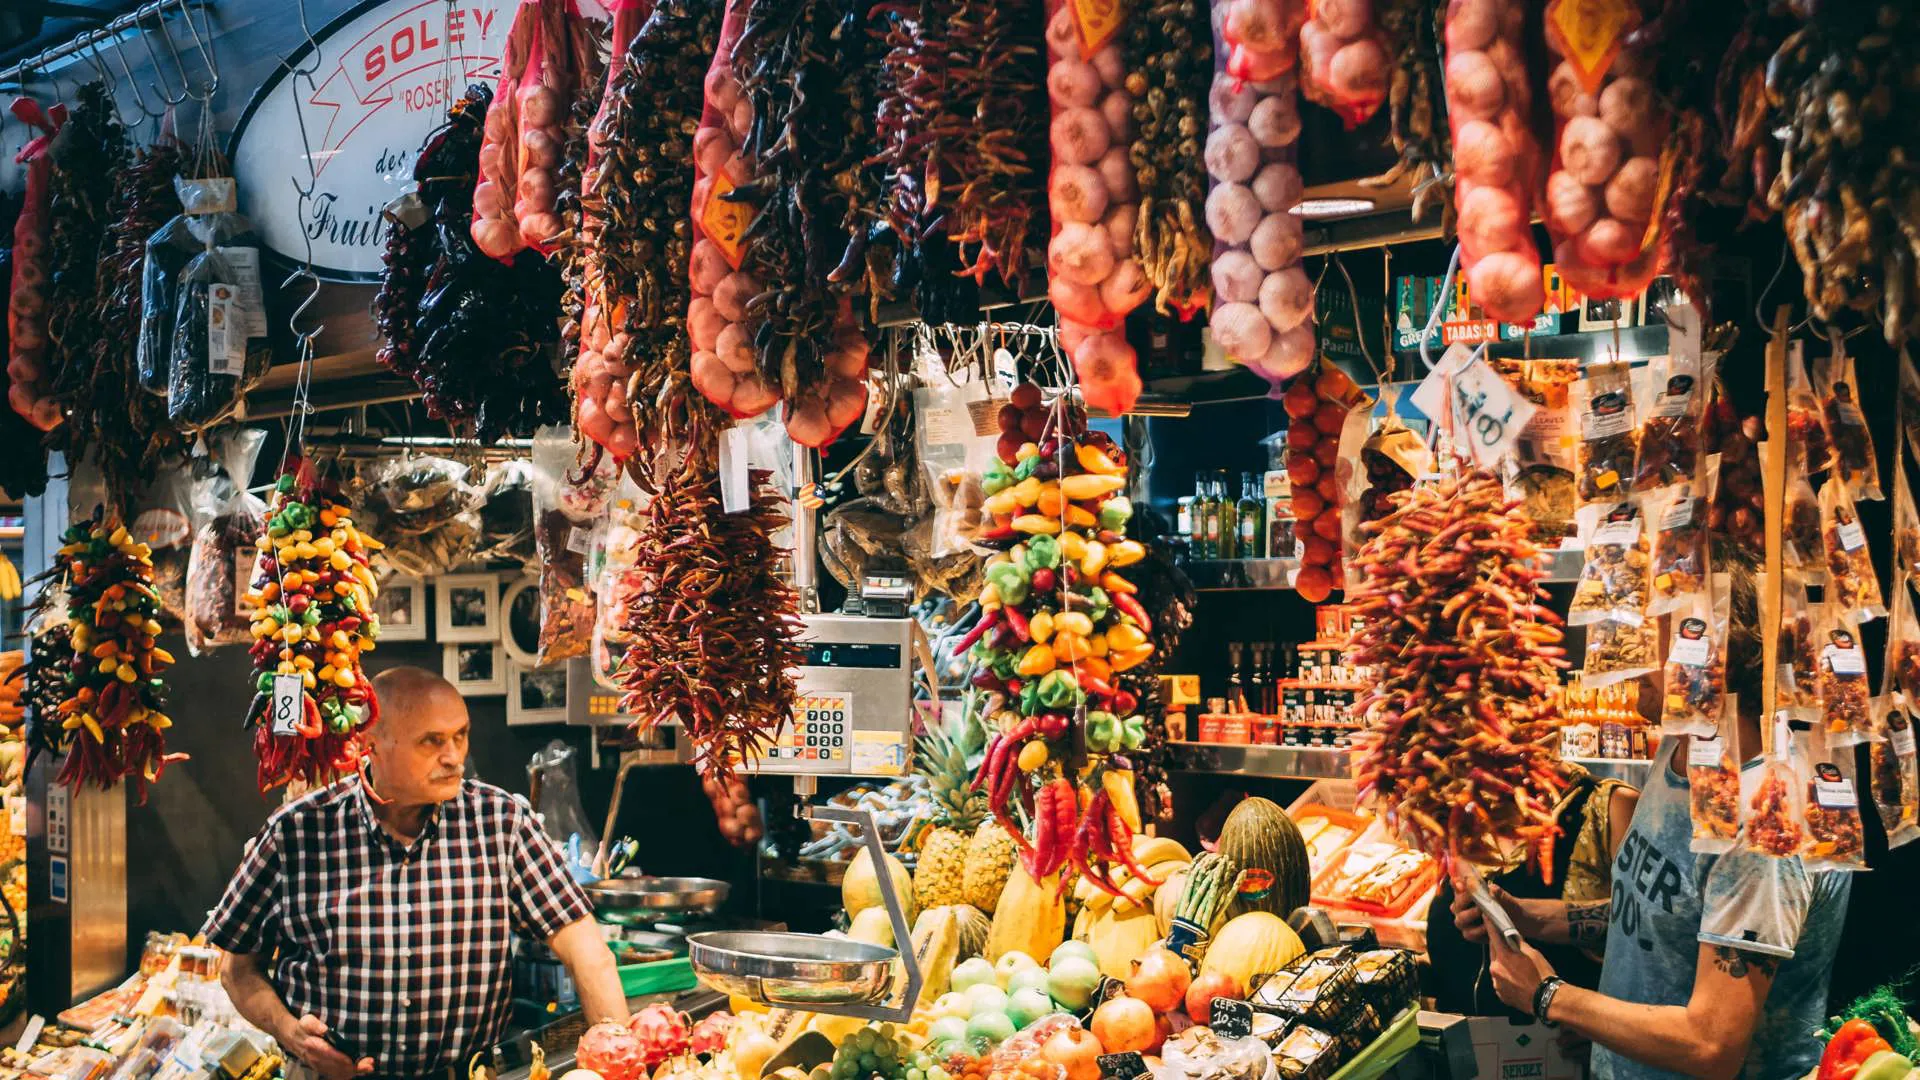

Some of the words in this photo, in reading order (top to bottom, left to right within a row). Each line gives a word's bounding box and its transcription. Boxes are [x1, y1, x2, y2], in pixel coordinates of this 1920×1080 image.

[365, 8, 494, 82] SOLEY
[1400, 326, 1439, 347] GREN
[822, 650, 831, 663] 0
[277, 695, 293, 720] 8
[1618, 829, 1681, 915] STER
[1214, 998, 1237, 1012] CEPS
